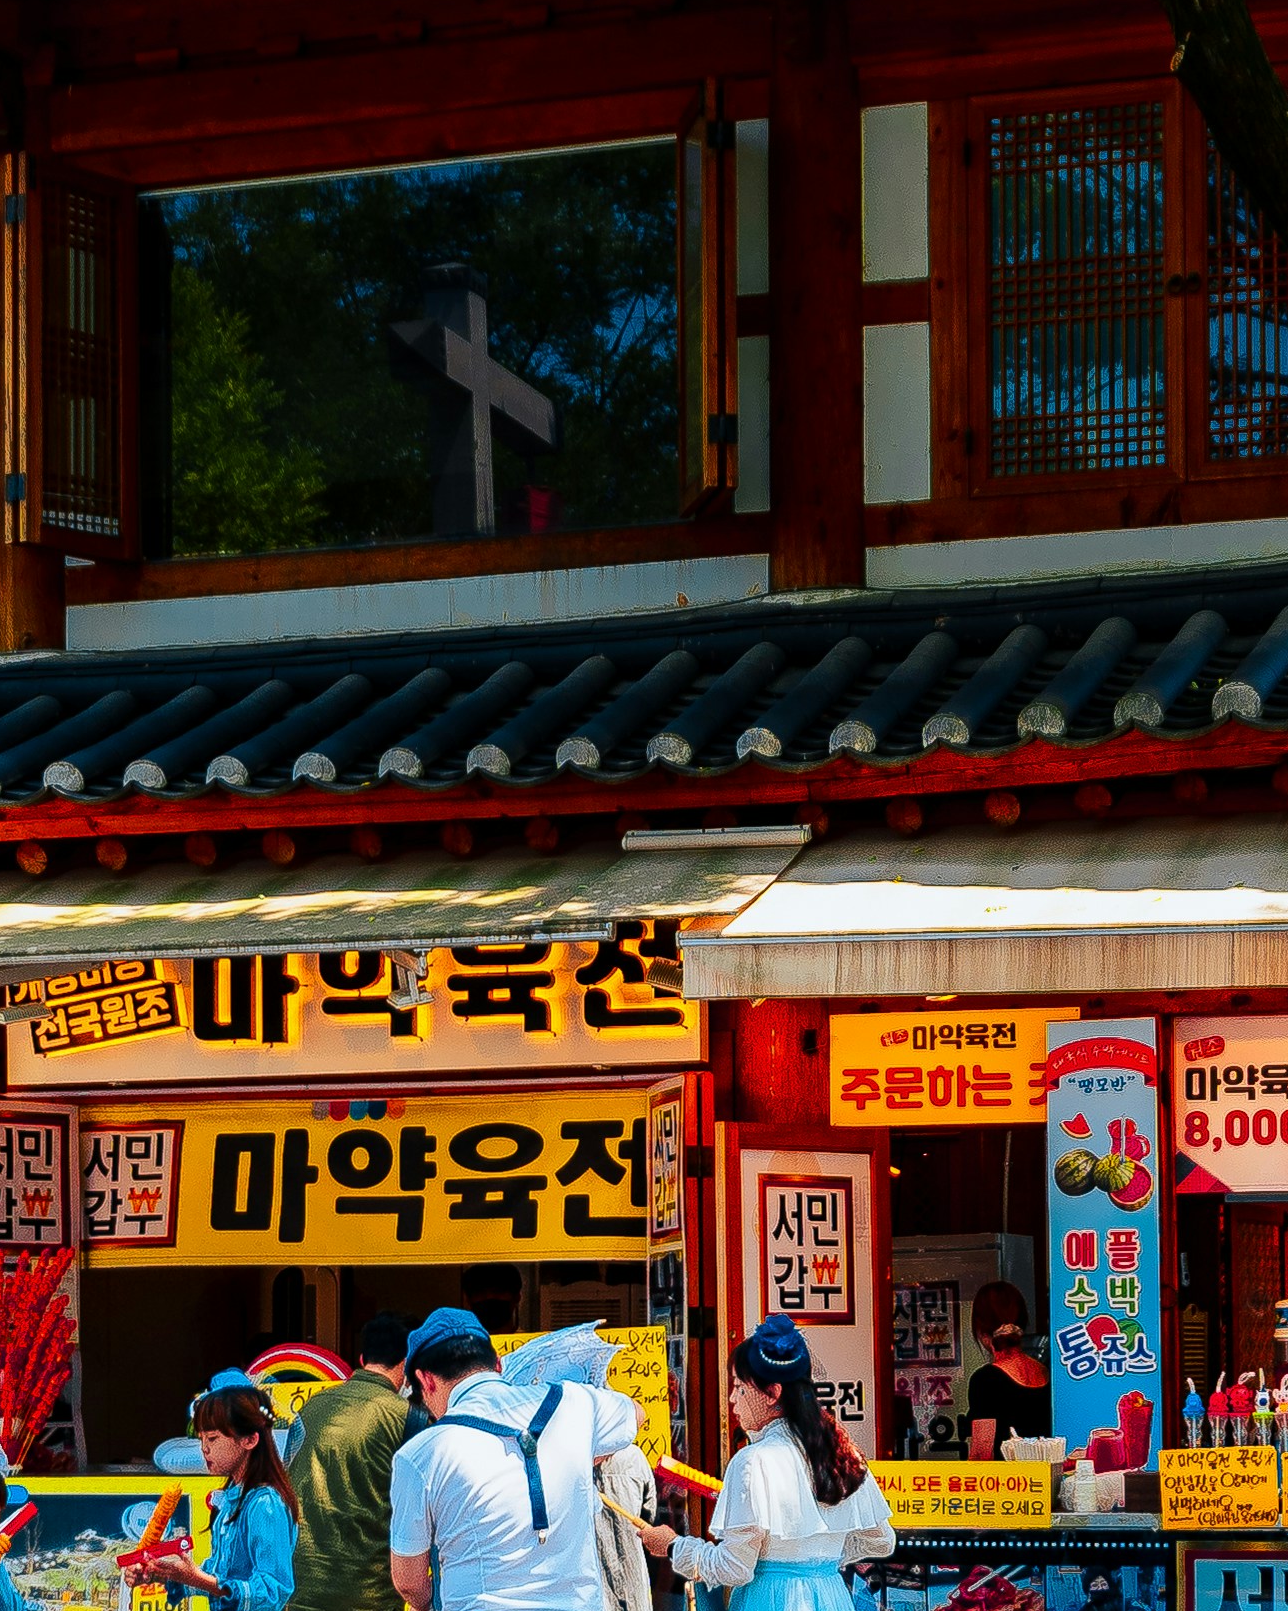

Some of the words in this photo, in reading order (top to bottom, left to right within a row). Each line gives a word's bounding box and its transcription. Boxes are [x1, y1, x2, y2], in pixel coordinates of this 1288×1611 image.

[912, 1022, 1017, 1050] 마약육전
[840, 1064, 1013, 1110] 주문하는
[84, 1132, 165, 1182] 서민
[210, 1117, 648, 1244] 마약육전
[772, 1192, 839, 1246] 서민
[1065, 1229, 1140, 1271] 애플
[1066, 1277, 1140, 1316] 수박
[912, 1475, 942, 1493] 모든
[897, 1499, 926, 1515] 바로
[930, 1497, 996, 1516] 카운터로
[1000, 1499, 1045, 1516] 오세요
